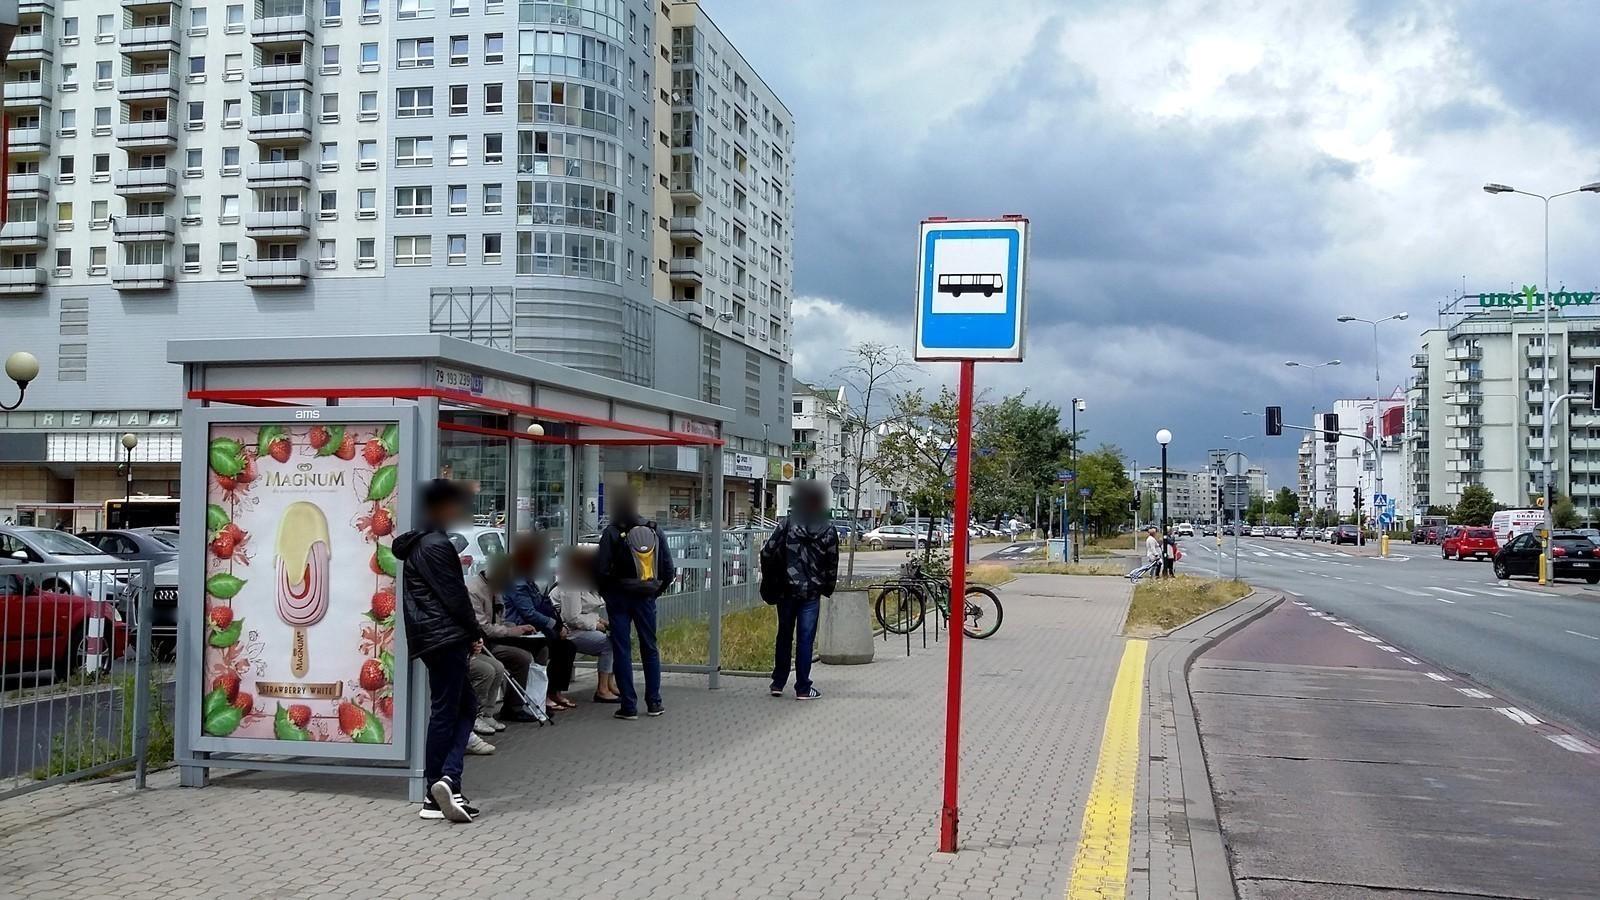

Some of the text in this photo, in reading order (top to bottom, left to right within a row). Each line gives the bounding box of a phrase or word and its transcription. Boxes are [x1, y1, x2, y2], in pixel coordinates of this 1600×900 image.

[1480, 285, 1594, 311] URSYNÓW
[436, 370, 444, 382] 79
[447, 373, 457, 385] 193
[459, 374, 470, 386] 239
[42, 413, 170, 425] REHAB
[295, 410, 320, 419] ams
[265, 470, 345, 487] MAGNUM
[260, 685, 333, 696] STRAWBERRY WHITE
